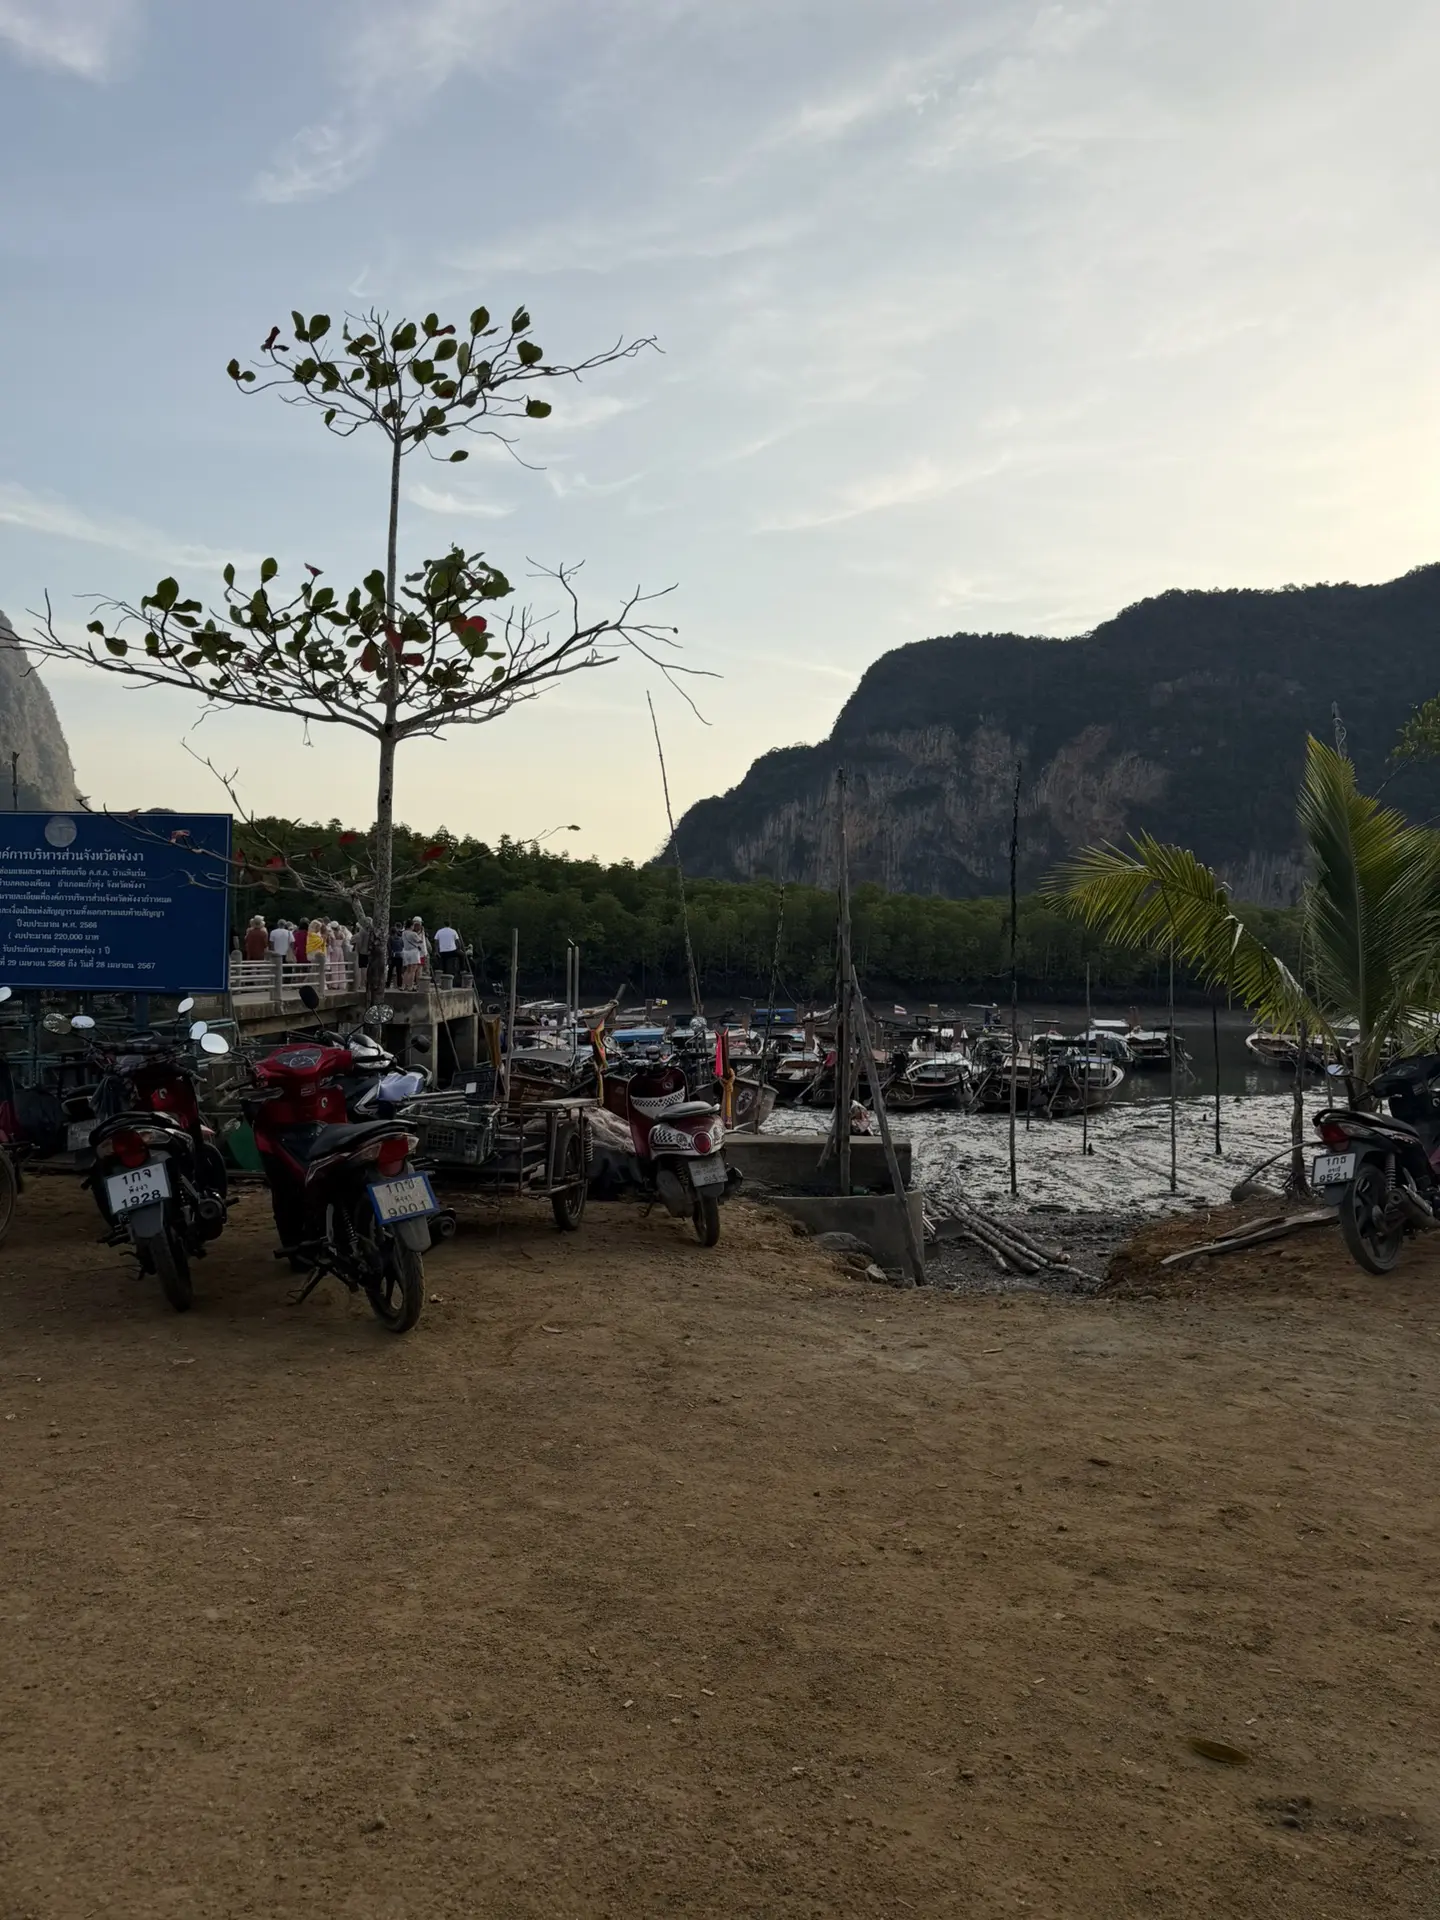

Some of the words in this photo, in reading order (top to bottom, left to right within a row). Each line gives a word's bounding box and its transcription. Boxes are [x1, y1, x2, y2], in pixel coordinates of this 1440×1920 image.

[0, 846, 144, 861] ค์การบริหารส่วนจังหวัดพังงา
[16, 918, 60, 928] ปีงบประมาณ
[62, 920, 78, 929] พ.ศ.
[14, 931, 52, 941] งบประมาณ
[54, 932, 83, 941] 220,000
[84, 933, 100, 941] บาท
[104, 945, 111, 955] ปี
[7, 959, 17, 967] 29
[18, 959, 46, 968] เมษายน
[67, 958, 77, 968] ถึง
[79, 956, 94, 968] วันที่
[107, 961, 135, 969] เมษายน
[137, 962, 156, 970] 2567
[1319, 1171, 1348, 1183] 9521
[121, 1189, 162, 1208] 1928
[387, 1200, 427, 1217] 9001
